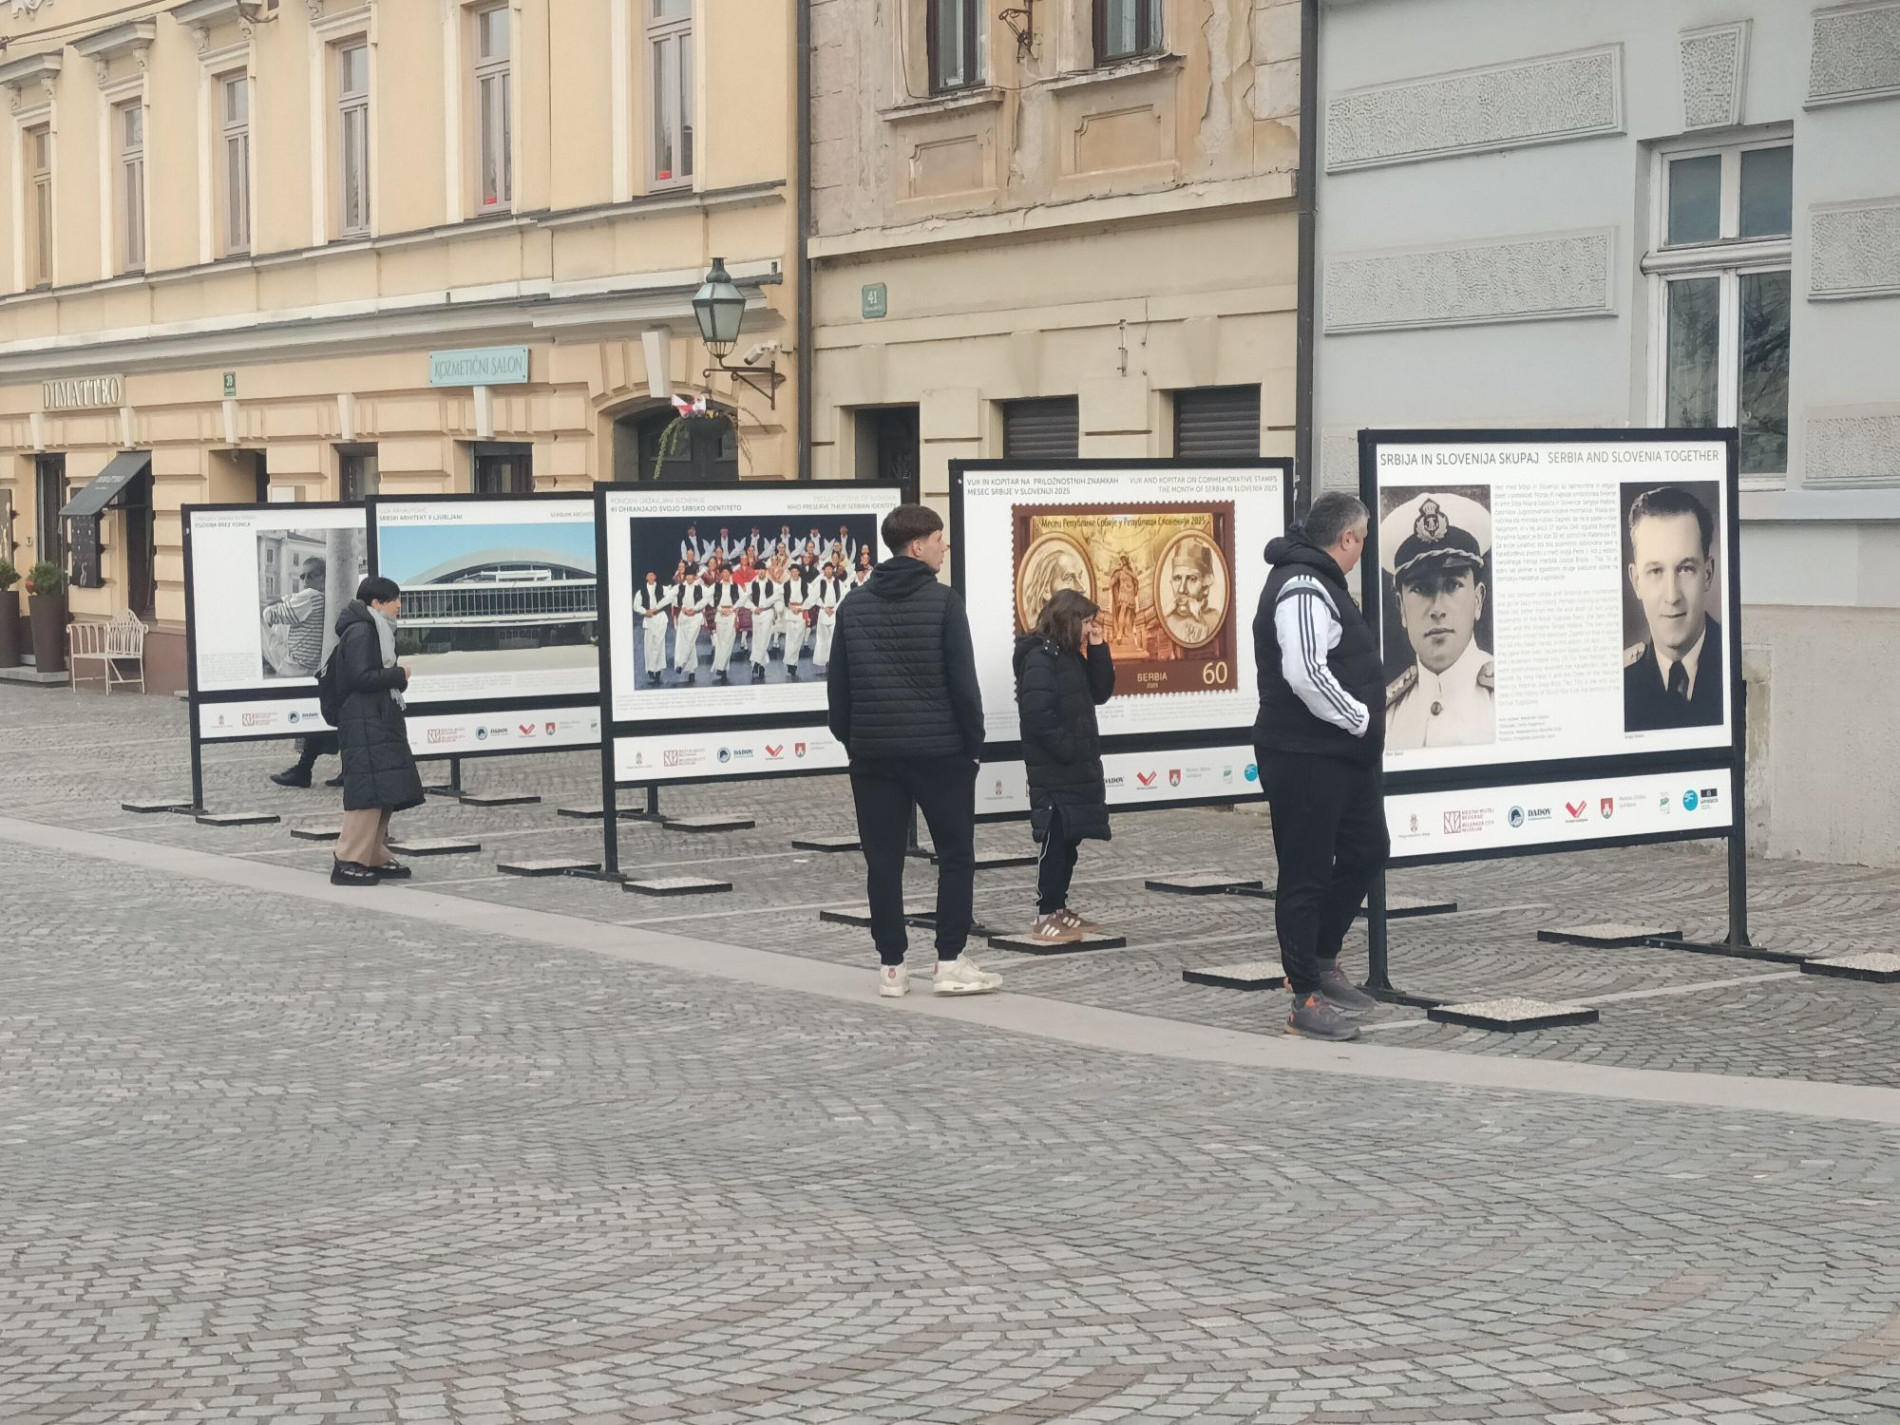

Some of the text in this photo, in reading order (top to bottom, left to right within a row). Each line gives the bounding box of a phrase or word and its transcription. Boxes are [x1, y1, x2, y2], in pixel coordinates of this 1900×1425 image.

[868, 290, 878, 305] 41
[434, 355, 523, 379] KOZMETIČNI SALON
[1380, 449, 1719, 466] SRBIJA IN SLOVENIJA SKUPAJ SERBIA AND SLOVENIA TOGETHER
[1033, 476, 1086, 485] PRILOŽNOSTNIH
[1087, 477, 1119, 485] ZNAMKAH
[1158, 476, 1185, 484] KOPITAR
[1197, 475, 1252, 483] COMMEMORATIVE
[967, 488, 990, 496] MESEC
[991, 488, 1013, 496] SRBIJE
[1020, 487, 1054, 495] SLOVENIJI
[1054, 487, 1071, 495] 2025
[1205, 485, 1225, 493] SERBIA
[1263, 484, 1278, 492] 2025
[618, 505, 658, 513] OHRANJAJO
[707, 504, 742, 512] IDENTITETO
[787, 503, 802, 511] WHO
[433, 513, 463, 521] LJUBLJANI
[1137, 672, 1168, 682] SERBIA
[1203, 661, 1228, 685] 60
